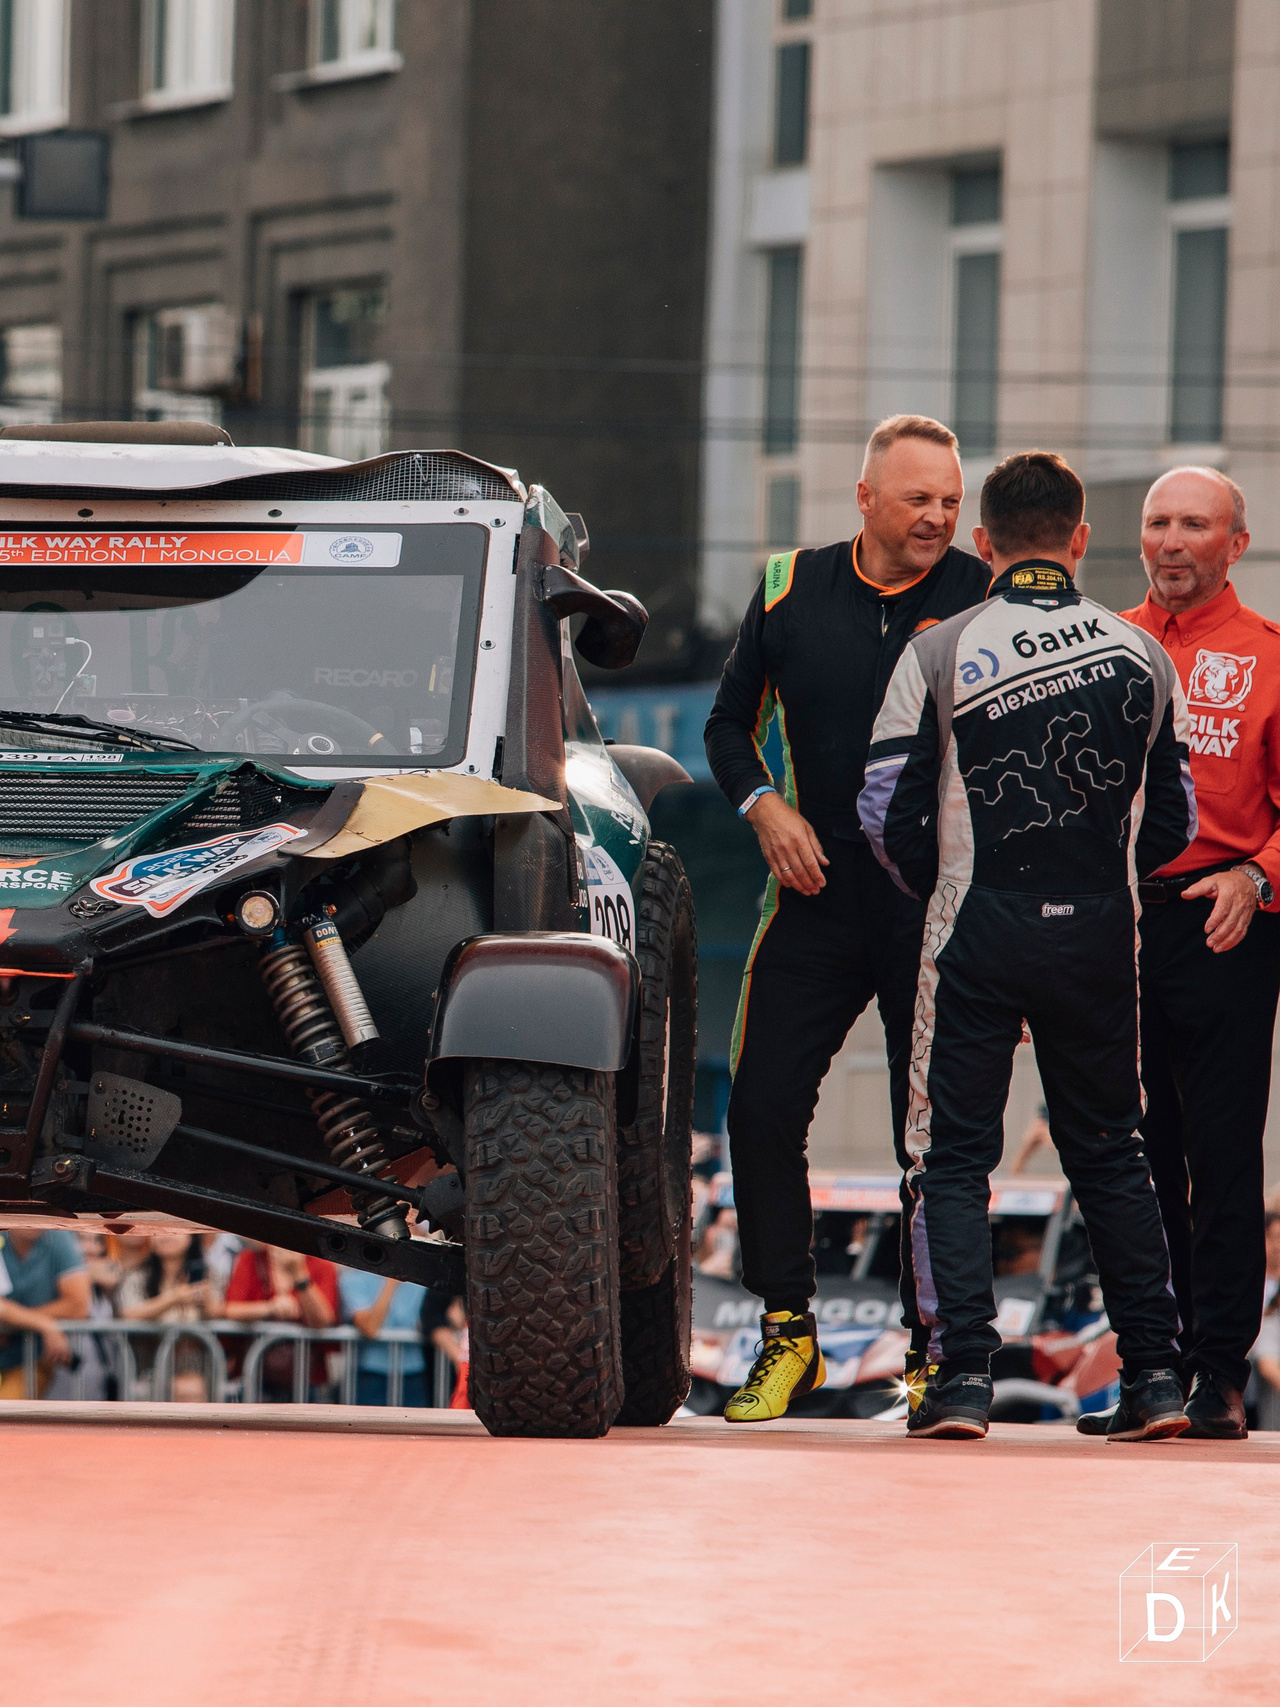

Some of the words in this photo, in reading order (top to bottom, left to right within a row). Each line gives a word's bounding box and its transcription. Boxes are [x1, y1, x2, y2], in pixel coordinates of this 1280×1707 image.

[44, 536, 102, 549] WAY
[108, 536, 188, 549] RALLY
[30, 549, 127, 561] EDITION
[160, 549, 291, 562] MONGOLIA
[1012, 618, 1109, 658] банк
[314, 667, 419, 687] RECARO
[986, 661, 1116, 721] alexbank.ru
[1188, 713, 1241, 739] SILK
[1188, 734, 1239, 758] WAY
[122, 859, 195, 894] SILK
[184, 838, 247, 862] WAY
[142, 852, 191, 872] 2025
[202, 854, 249, 874] 208
[1041, 902, 1075, 918] freem
[594, 893, 632, 952] 208
[962, 1380, 987, 1389] balance
